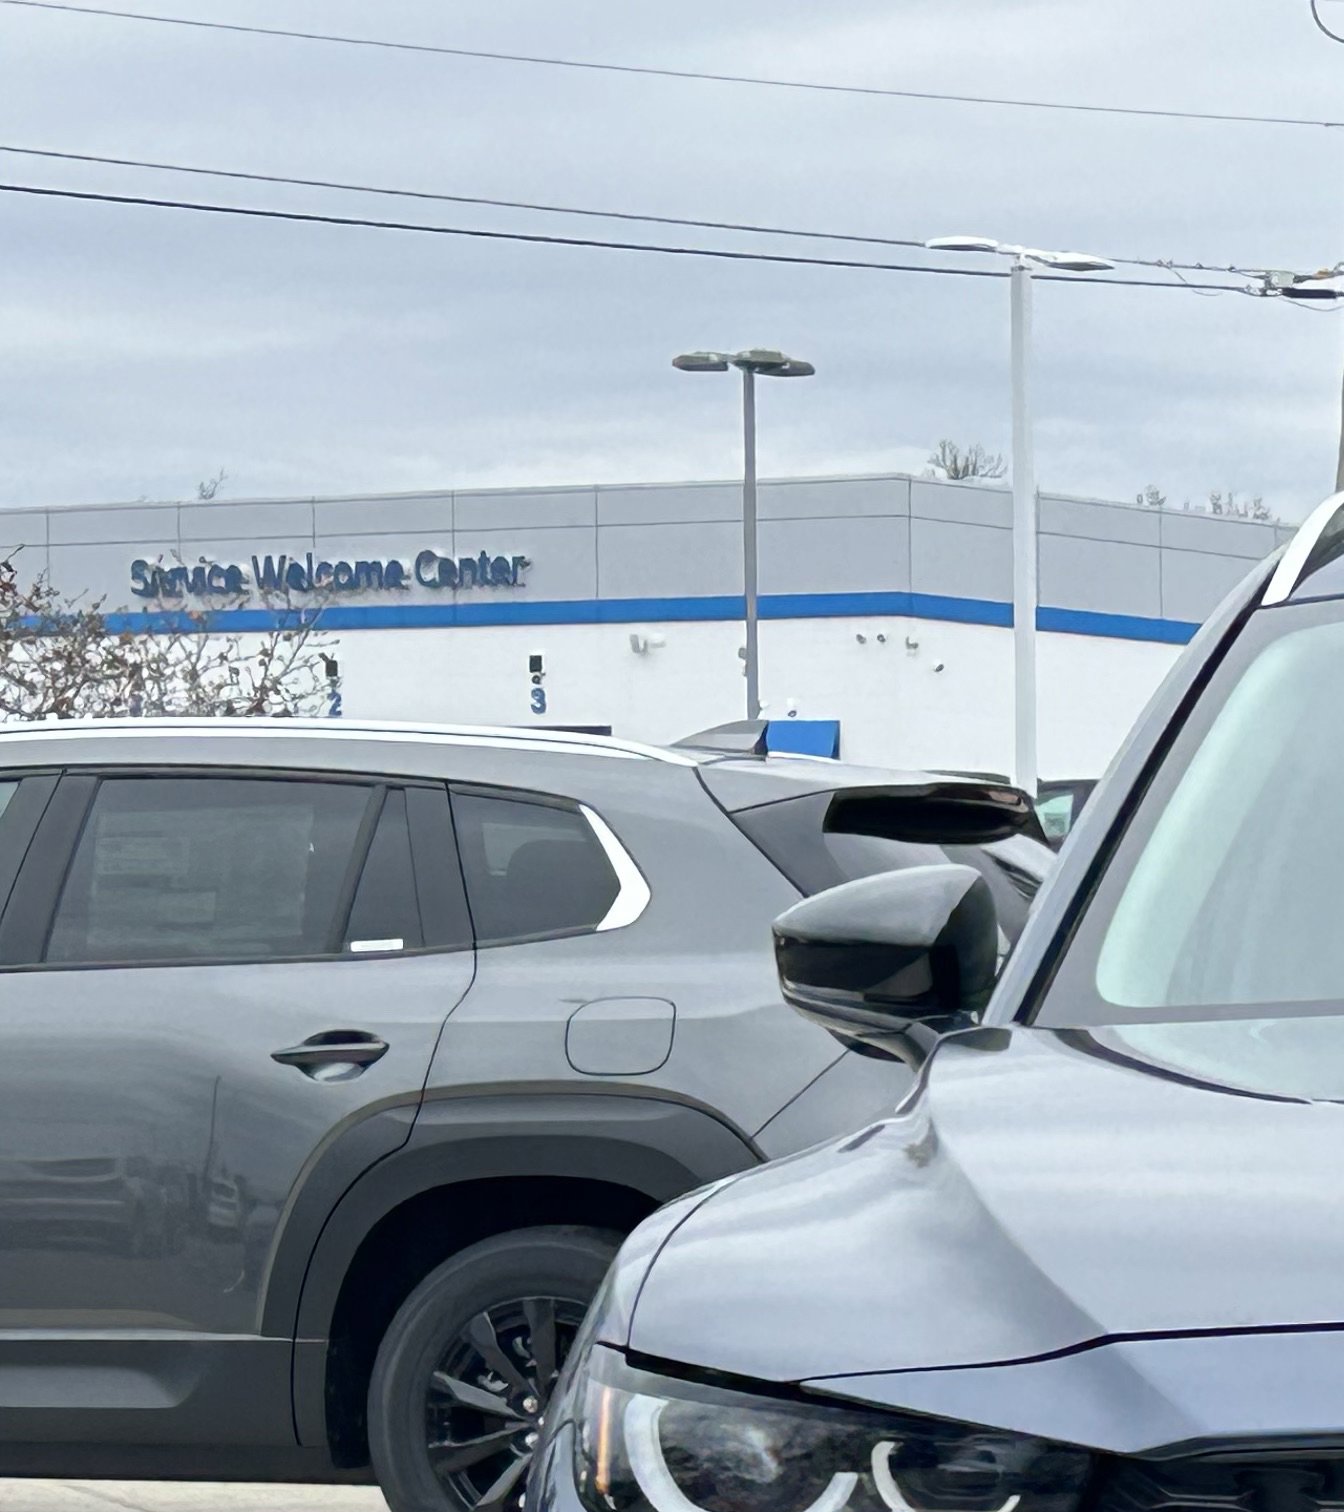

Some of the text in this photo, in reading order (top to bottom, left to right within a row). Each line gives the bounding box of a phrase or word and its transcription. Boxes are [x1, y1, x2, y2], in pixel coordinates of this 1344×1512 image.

[131, 549, 528, 597] Service Welcome Center
[327, 690, 342, 716] 2
